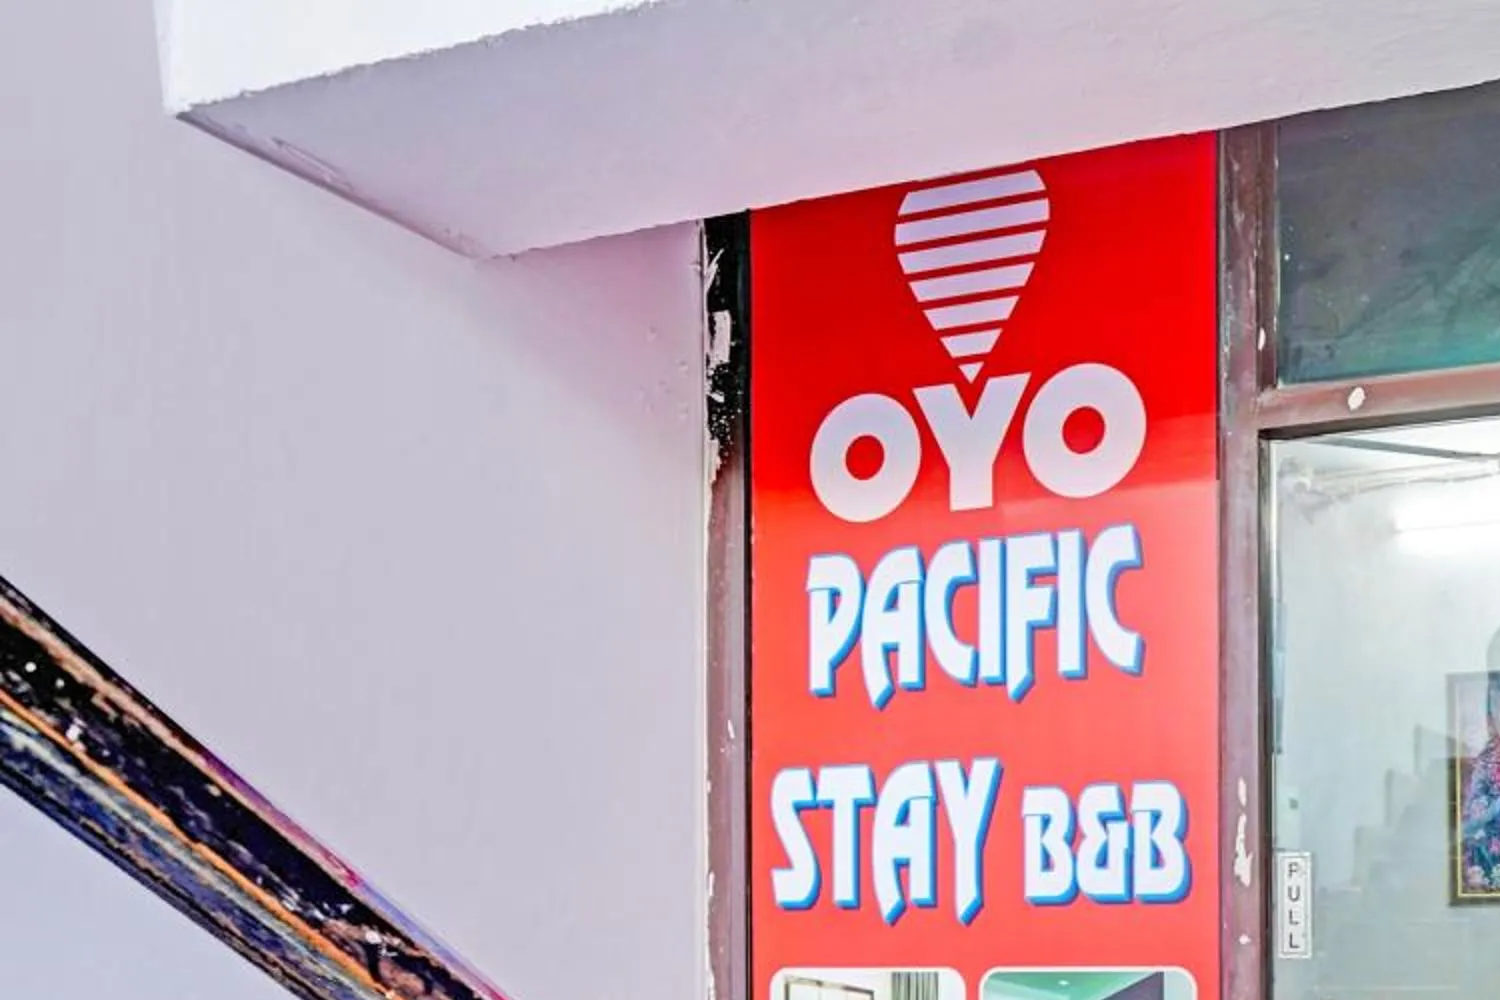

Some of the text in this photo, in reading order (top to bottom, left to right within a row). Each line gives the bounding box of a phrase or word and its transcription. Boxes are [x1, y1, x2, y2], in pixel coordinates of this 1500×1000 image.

[810, 363, 1147, 522] OYO
[806, 524, 1145, 709] PACIFIC
[771, 757, 1192, 925] STAY B&B
[1287, 861, 1301, 949] PULL
